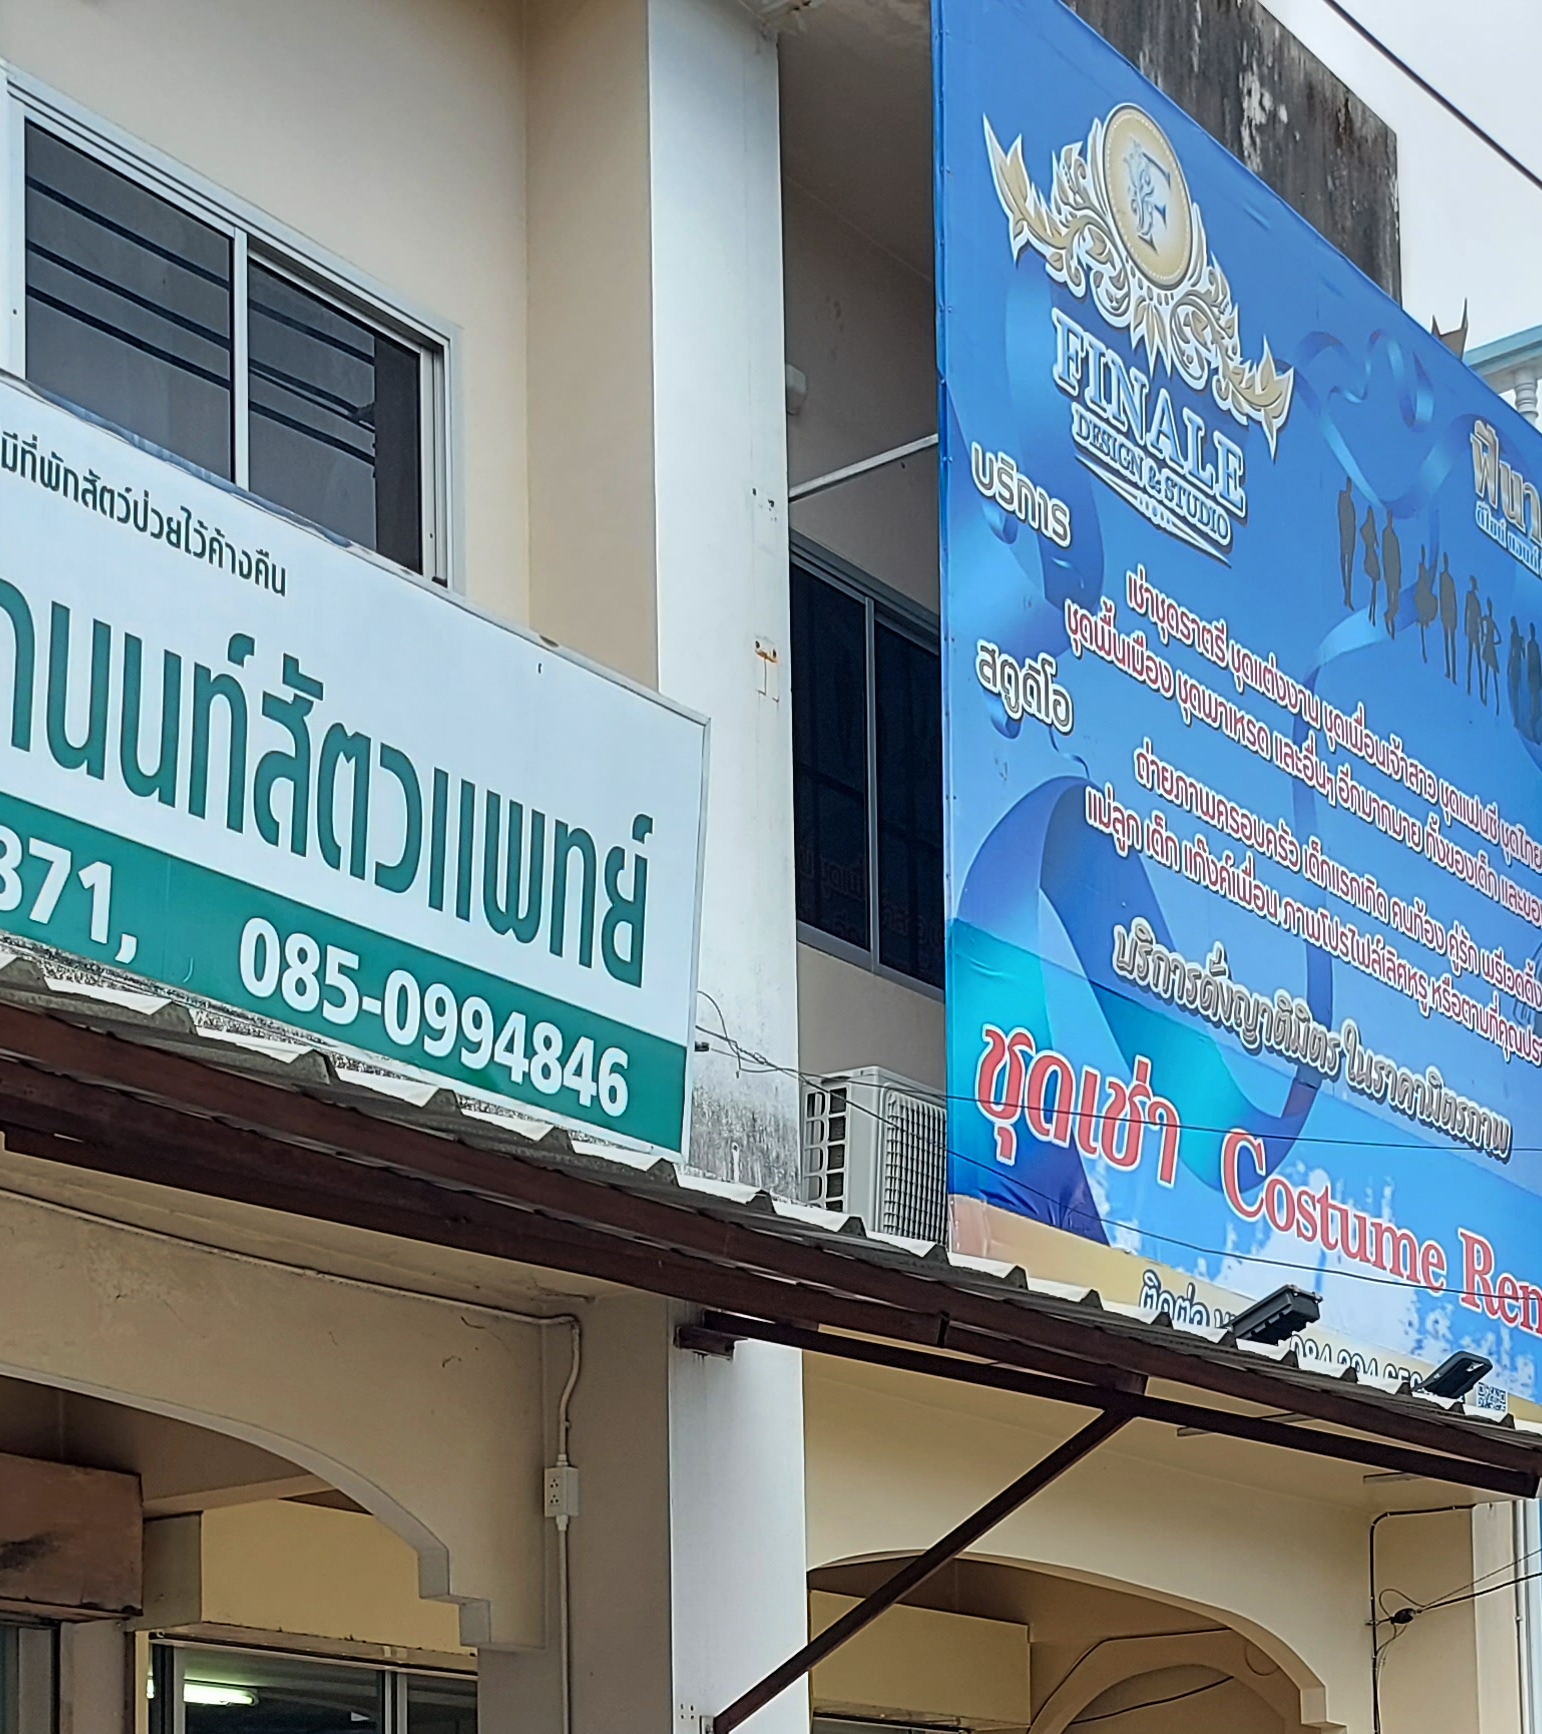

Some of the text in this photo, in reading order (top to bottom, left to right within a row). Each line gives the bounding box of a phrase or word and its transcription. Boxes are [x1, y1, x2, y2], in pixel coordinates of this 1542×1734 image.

[971, 441, 1071, 548] บริการ
[1052, 308, 1246, 518] FINALE
[1073, 404, 1145, 482] DESIGN
[1162, 470, 1231, 545] STUDIO
[976, 638, 1074, 734] สตูดิโอ
[1065, 596, 1174, 699] ชุดพื้นเมือง
[1176, 670, 1271, 761] ชุดพาเหรด
[1273, 729, 1336, 807] และอื่นๆ
[1337, 763, 1422, 851] อีกมากมาย
[1424, 812, 1499, 901] ทั้งของเด็ก
[1126, 563, 1228, 669] เช่าชุดราตรี
[1229, 640, 1321, 729] ชุดแต่งงาน
[1323, 701, 1438, 804] ชุดเพื่อนเจ้าสาว
[1439, 779, 1500, 846] ชุดแฟนซี
[1085, 781, 1143, 858] แม่ลูก
[1145, 809, 1181, 873] เด็ก
[1134, 736, 1301, 873] ถ่ายภาพครอบครัว
[1303, 836, 1389, 924] เด็กแรกเกิด
[1391, 896, 1447, 956] คนท้อง
[1448, 920, 1480, 978] คู่รัก
[239, 917, 630, 1117] 085-0994846
[975, 1024, 1181, 1190] ชุดเช่า
[1221, 1129, 1447, 1296] Costume
